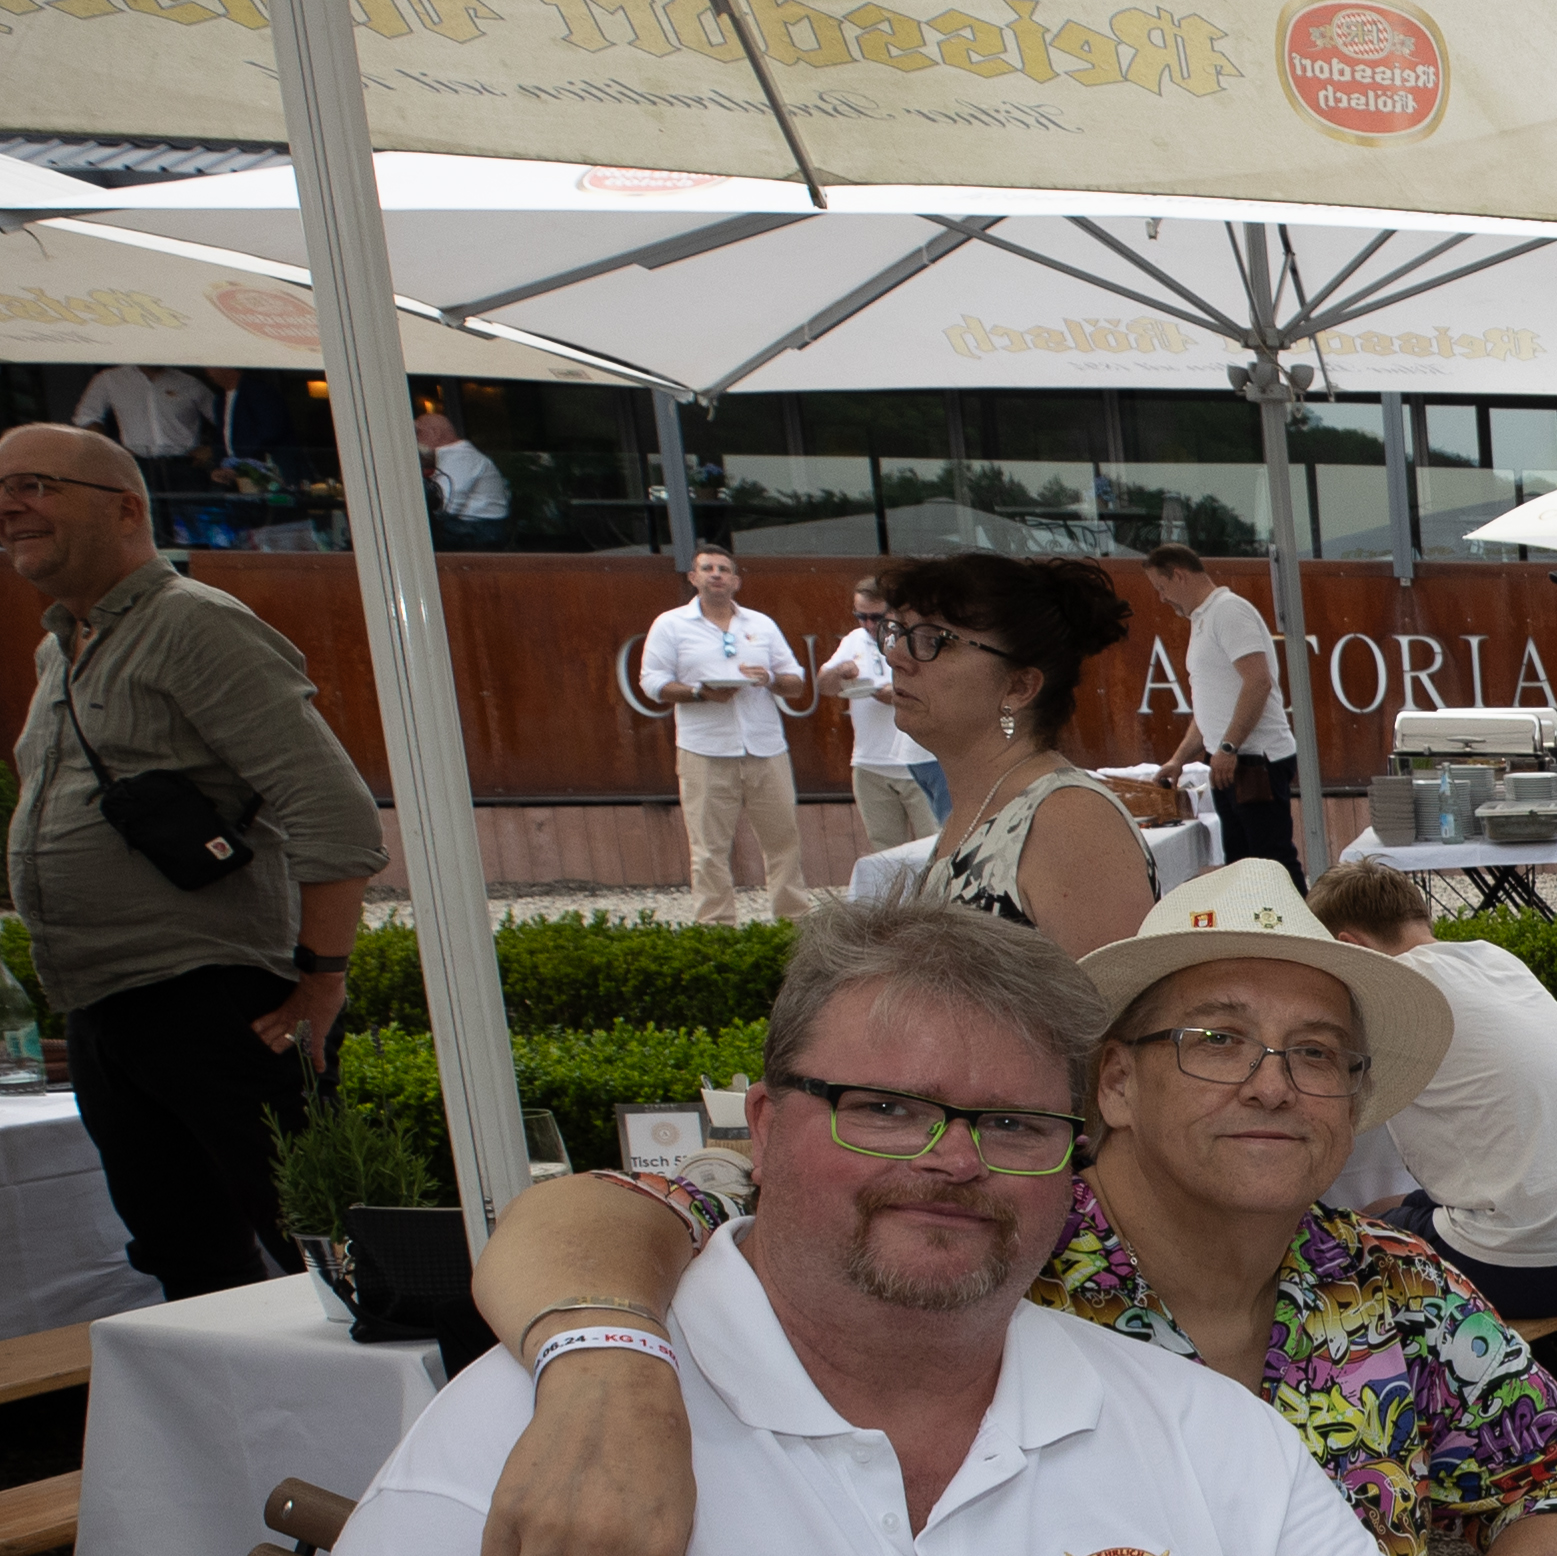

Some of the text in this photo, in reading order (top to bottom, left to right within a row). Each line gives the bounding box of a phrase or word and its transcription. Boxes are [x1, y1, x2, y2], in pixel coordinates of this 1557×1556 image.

[631, 1155, 687, 1168] Tisch 5
[604, 1333, 634, 1344] KG
